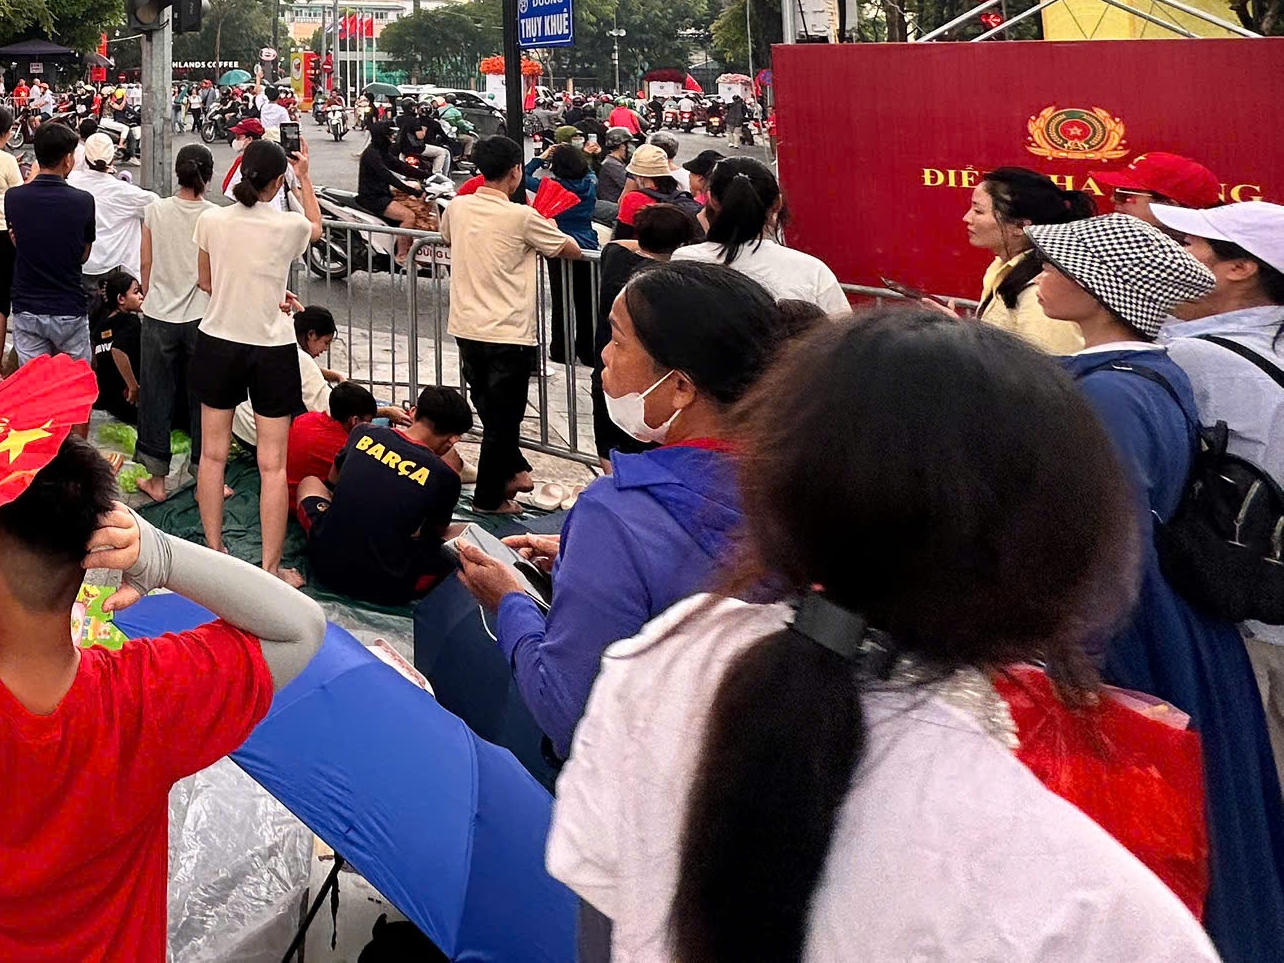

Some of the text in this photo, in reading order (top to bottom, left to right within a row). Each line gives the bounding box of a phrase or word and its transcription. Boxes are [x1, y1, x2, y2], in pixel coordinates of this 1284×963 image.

[520, 8, 569, 42] THỤY KHUÊ
[172, 61, 239, 69] HLANDS COFFEE
[921, 165, 994, 189] ĐIỂ
[356, 435, 430, 486] BARÇA
